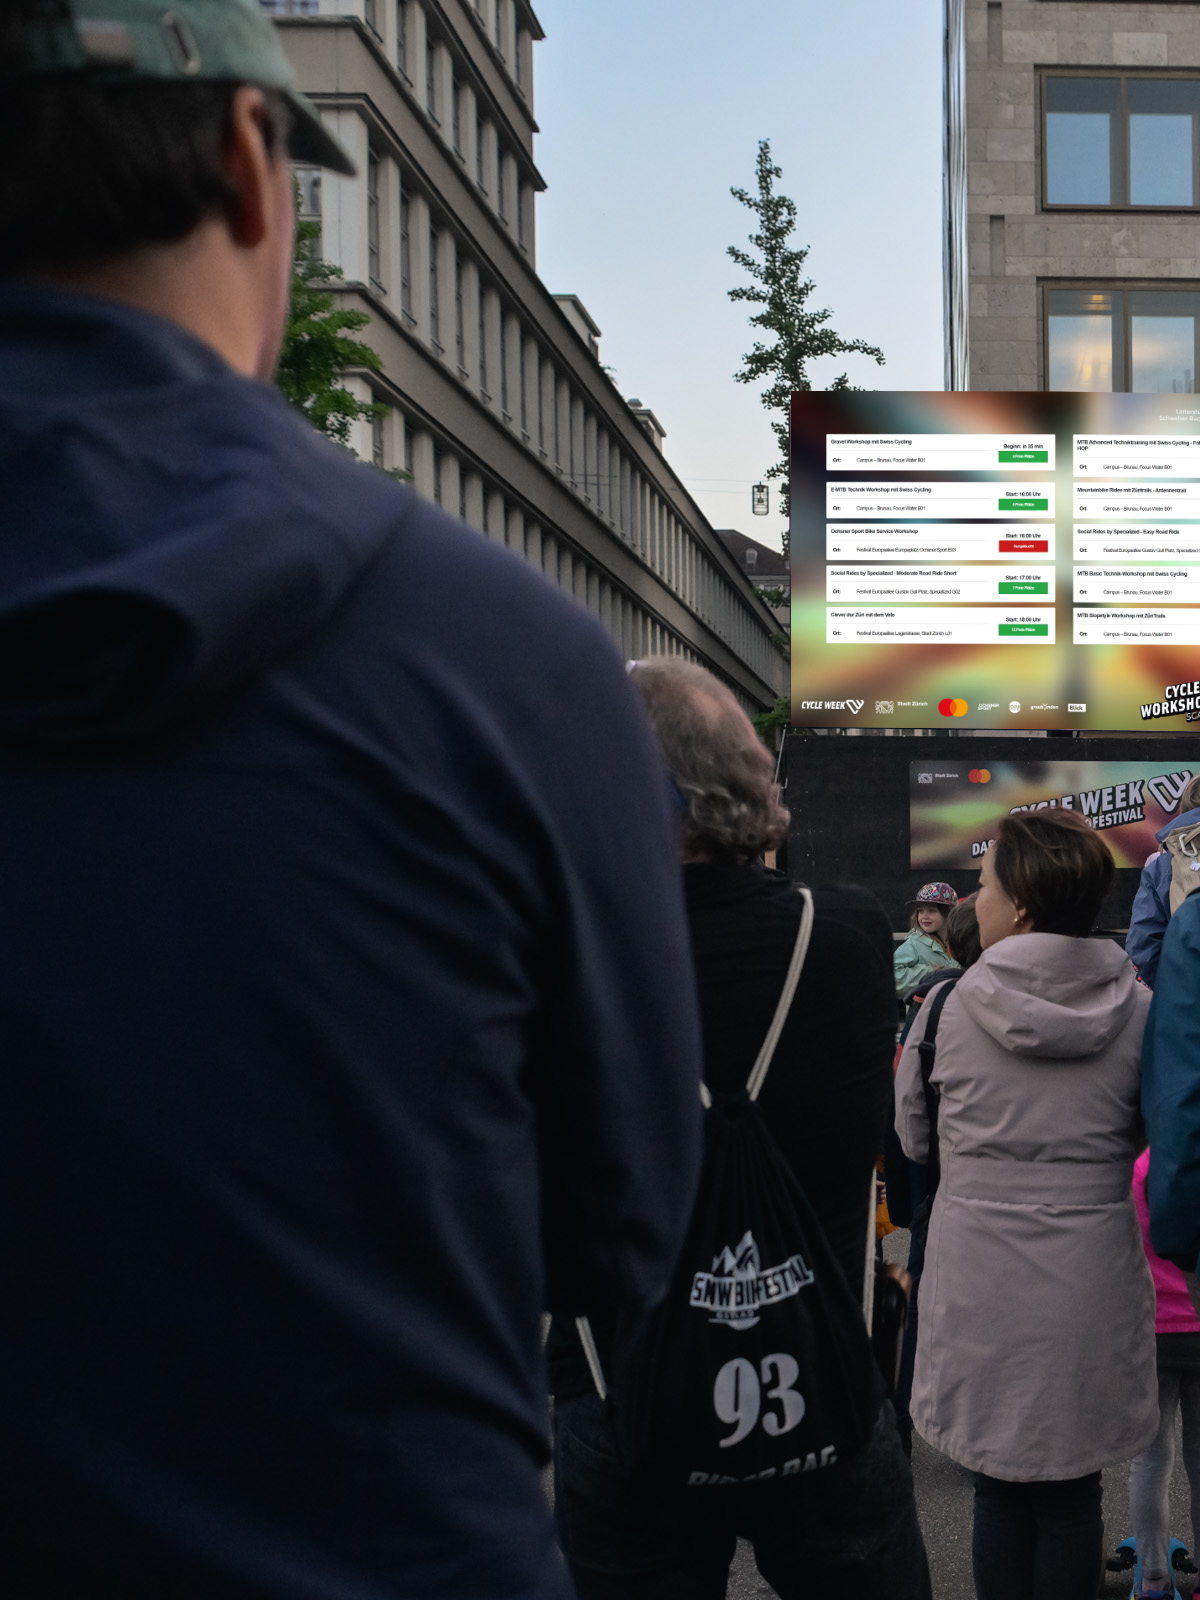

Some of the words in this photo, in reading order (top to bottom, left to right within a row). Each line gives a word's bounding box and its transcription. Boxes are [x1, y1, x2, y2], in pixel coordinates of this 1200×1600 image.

[1164, 681, 1200, 700] CYCLE
[801, 701, 823, 710] CYCLE
[824, 701, 846, 710] WEEK
[1079, 780, 1144, 816] WEEK
[713, 1352, 806, 1449] 93
